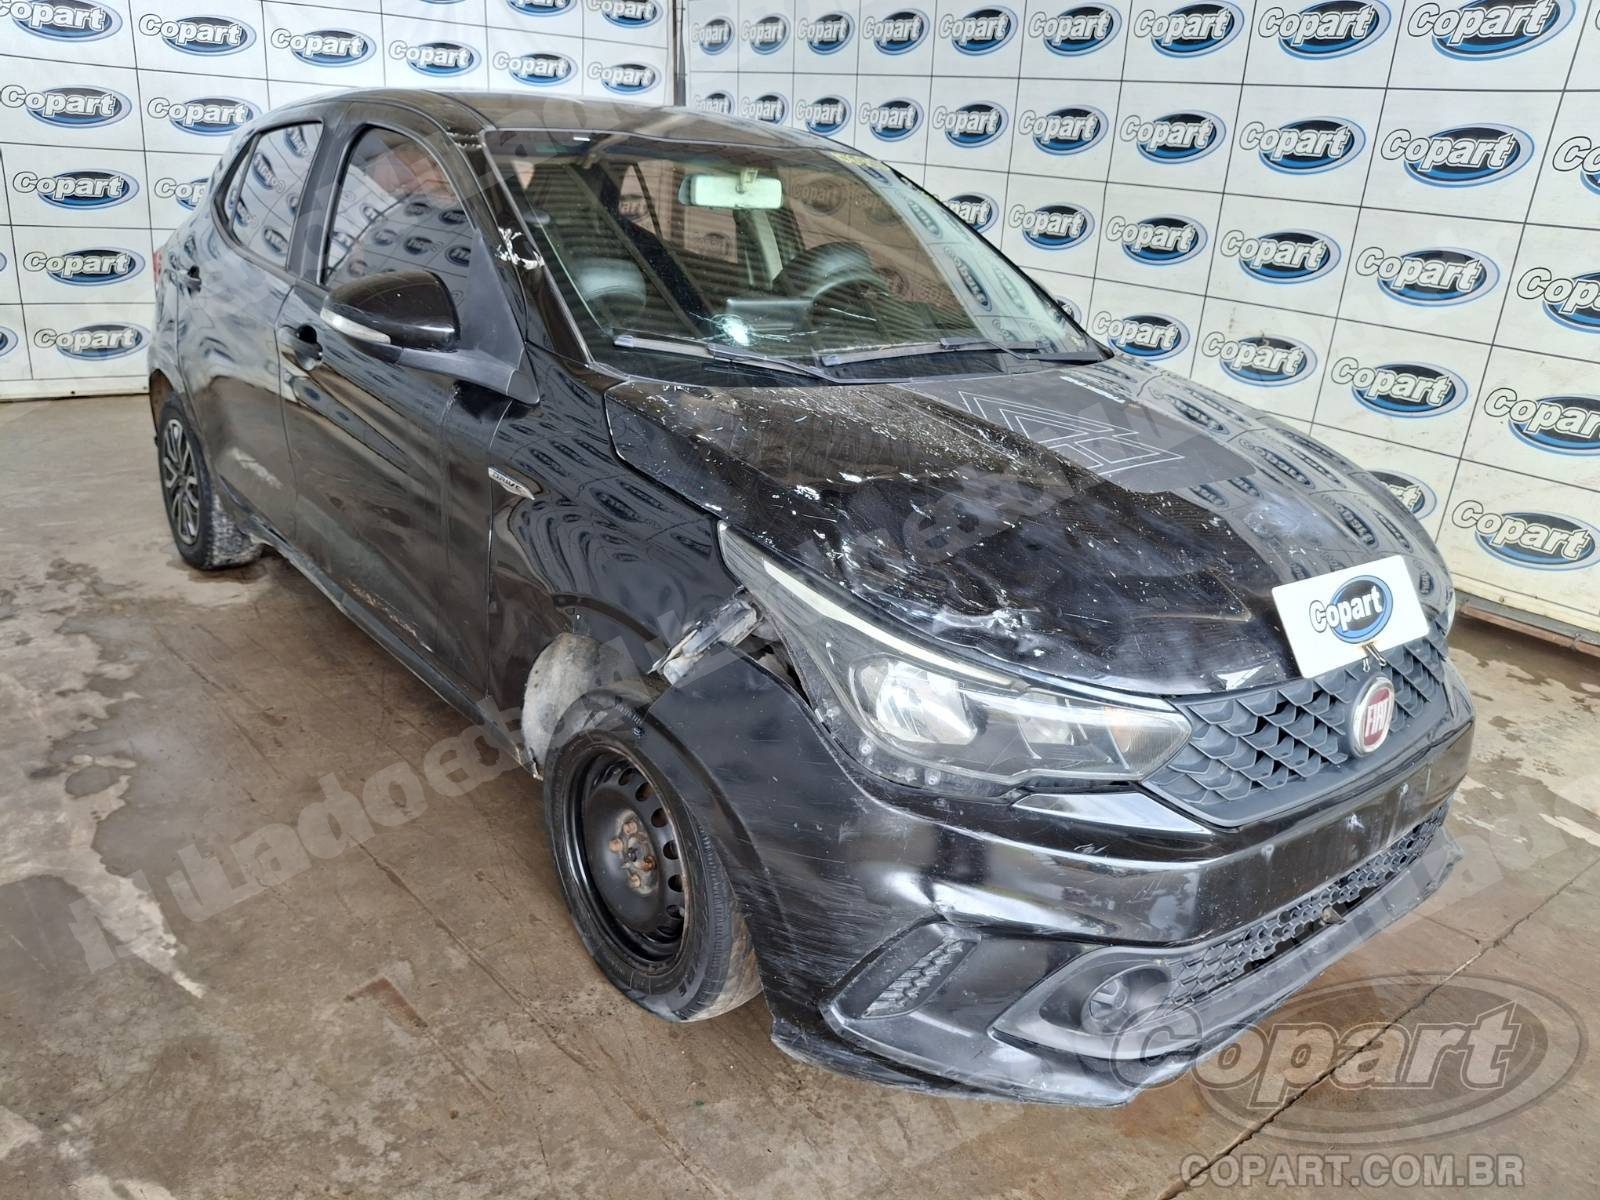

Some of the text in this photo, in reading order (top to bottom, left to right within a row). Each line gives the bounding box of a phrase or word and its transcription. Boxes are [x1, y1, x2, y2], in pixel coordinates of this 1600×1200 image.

[138, 13, 242, 45] Copart
[690, 22, 730, 47] Copart
[741, 18, 784, 46] Copart
[796, 16, 848, 47] Copart
[862, 11, 926, 46] Copart
[939, 9, 1012, 45] Copart
[1029, 9, 1111, 45] Copart
[1134, 8, 1230, 45] Copart
[1258, 3, 1375, 47] Copart
[1408, 0, 1557, 46] Copart
[271, 29, 363, 57] Copart
[388, 40, 472, 68] Copart
[492, 51, 569, 79] Copart
[586, 62, 652, 88] Copart
[1, 84, 119, 116] Copart
[147, 96, 251, 125] Copart
[741, 96, 783, 121] Copart
[795, 99, 845, 128] Copart
[859, 102, 917, 134] Copart
[932, 105, 999, 137] Copart
[1018, 110, 1099, 143] Copart
[1120, 115, 1214, 151] Copart
[1239, 121, 1350, 160] Copart
[1381, 129, 1515, 171] Copart
[13, 171, 126, 199] Copart
[154, 178, 207, 203] Cop
[948, 199, 991, 224] part
[1008, 204, 1085, 238] Copart
[1105, 216, 1197, 252] Copart
[1220, 230, 1329, 271] Copart
[23, 251, 132, 278] Copart
[1355, 247, 1483, 291] Copart
[1517, 267, 1600, 314] Cop
[33, 328, 138, 353] Copart
[1093, 311, 1179, 348] Copart
[1202, 331, 1305, 376] Copart
[1331, 357, 1452, 405] Copart
[1484, 388, 1600, 439] Copar
[1452, 500, 1590, 561] Copart
[1309, 585, 1383, 633] Copart
